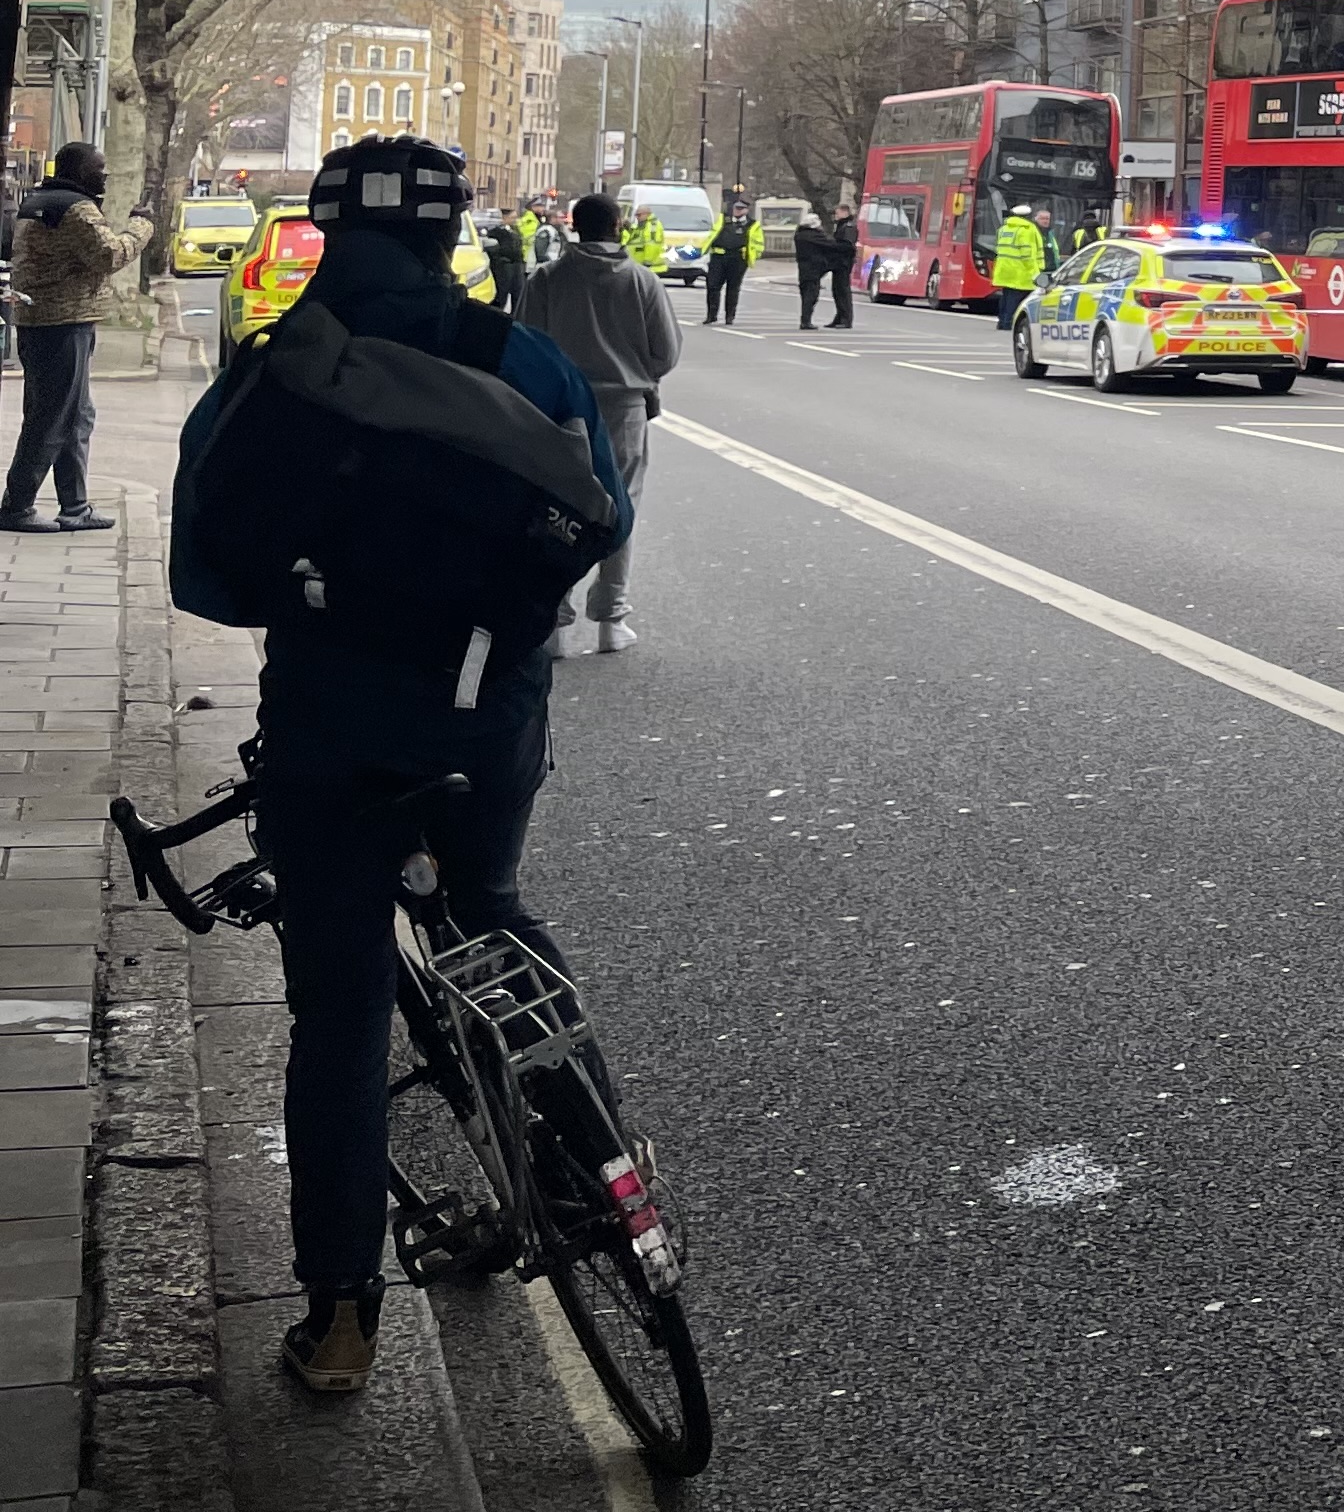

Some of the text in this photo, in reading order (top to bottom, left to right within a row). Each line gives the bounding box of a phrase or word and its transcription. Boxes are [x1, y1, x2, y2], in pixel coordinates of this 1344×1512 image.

[1074, 160, 1097, 177] 136
[1040, 323, 1090, 341] POLICE
[1199, 342, 1267, 352] POLICE
